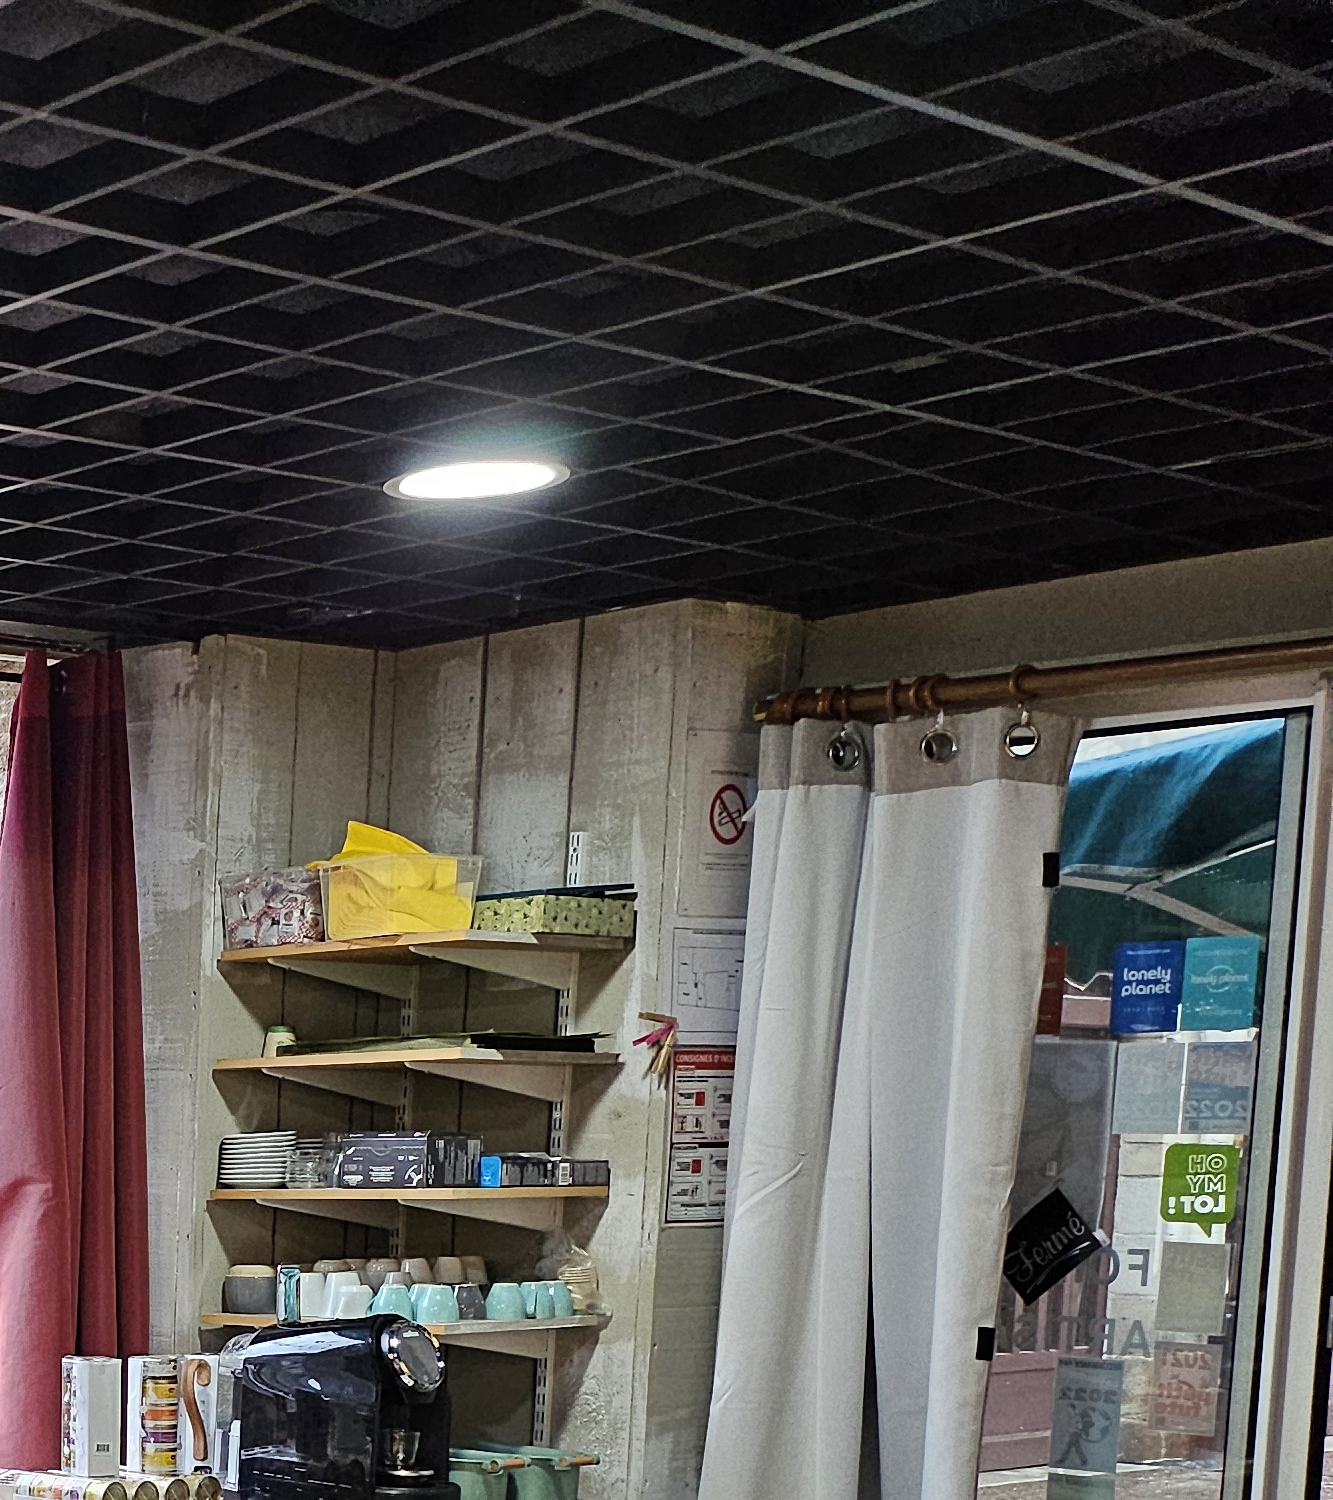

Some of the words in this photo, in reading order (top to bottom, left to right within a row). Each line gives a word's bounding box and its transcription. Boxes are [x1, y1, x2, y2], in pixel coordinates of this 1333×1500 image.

[1123, 966, 1171, 983] lonely
[1121, 982, 1171, 997] planet
[675, 1053, 712, 1063] CONSIGNES
[1004, 1208, 1088, 1283] Fermé
